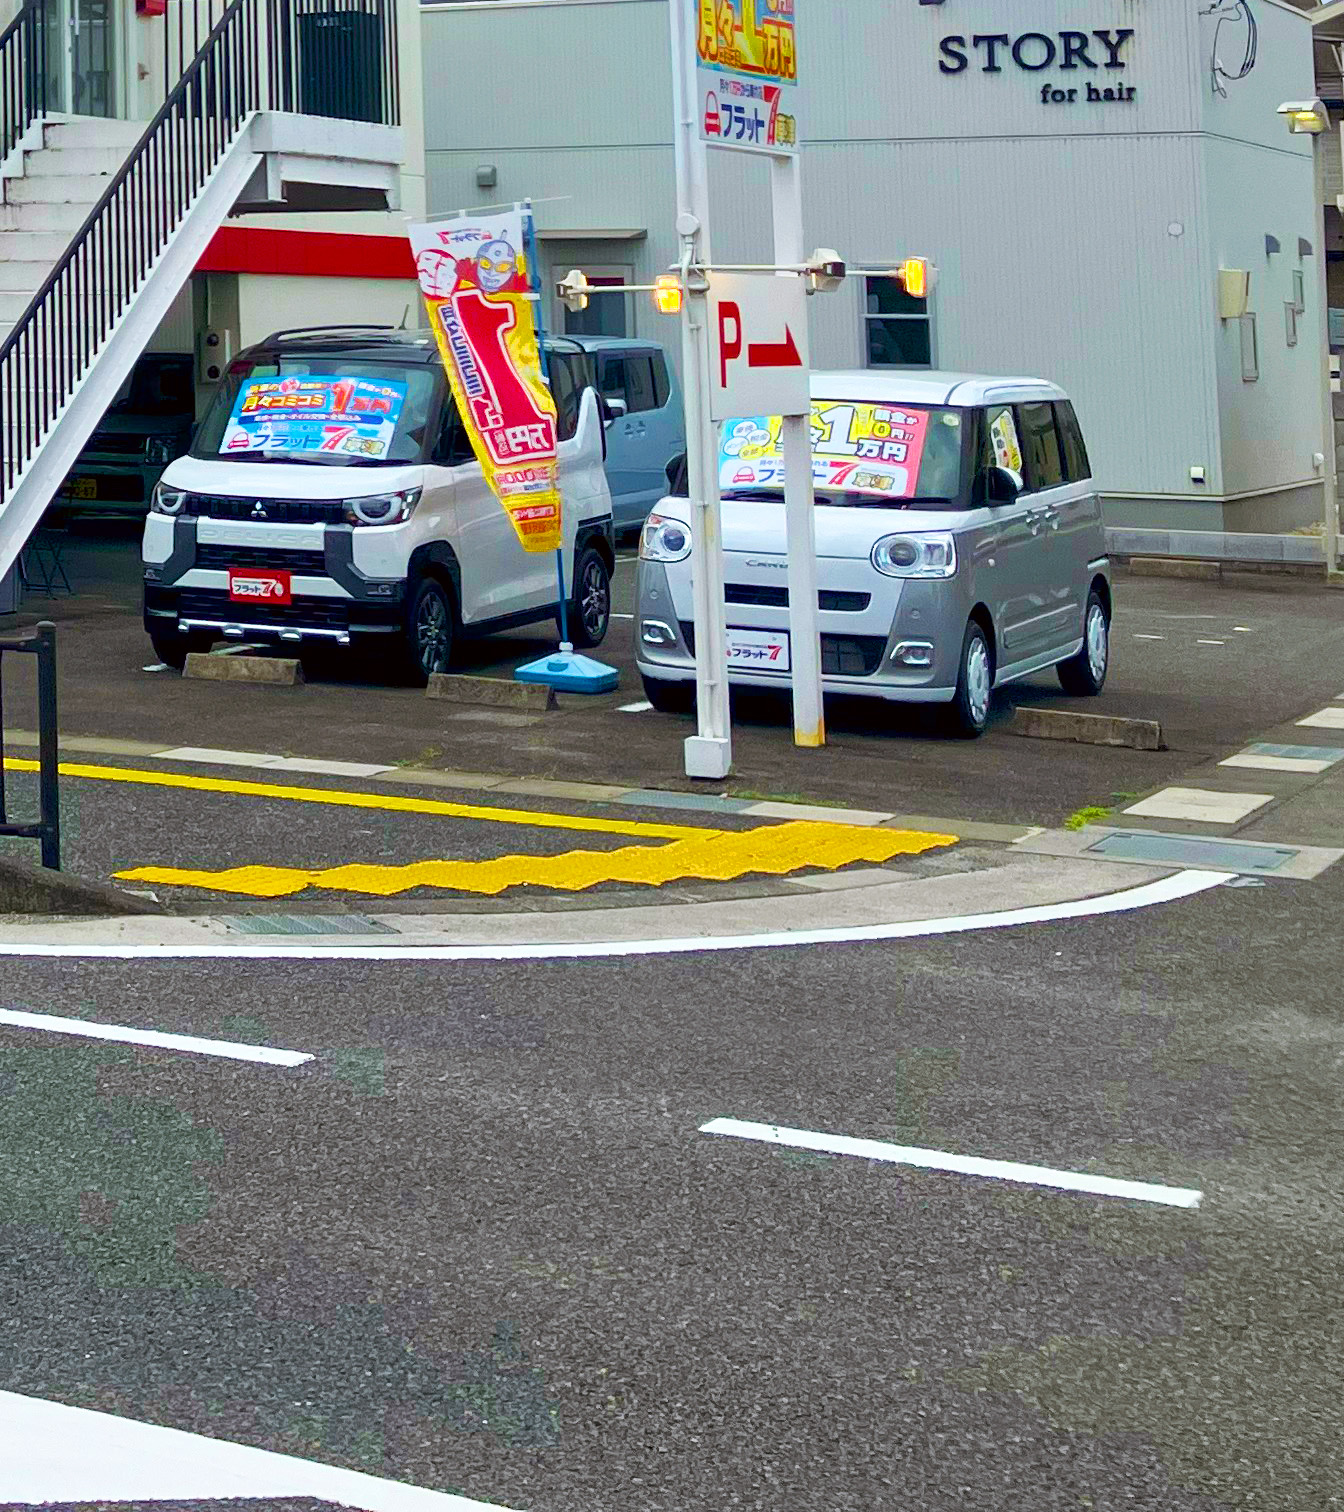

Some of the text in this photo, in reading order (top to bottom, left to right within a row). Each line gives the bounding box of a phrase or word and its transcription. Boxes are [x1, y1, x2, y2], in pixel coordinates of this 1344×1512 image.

[939, 29, 1134, 74] STORY
[1040, 82, 1137, 103] for hair
[718, 301, 742, 388] P
[241, 393, 326, 412] 月々コミコミ
[856, 439, 909, 463] 万円
[732, 644, 783, 661] フラット7
